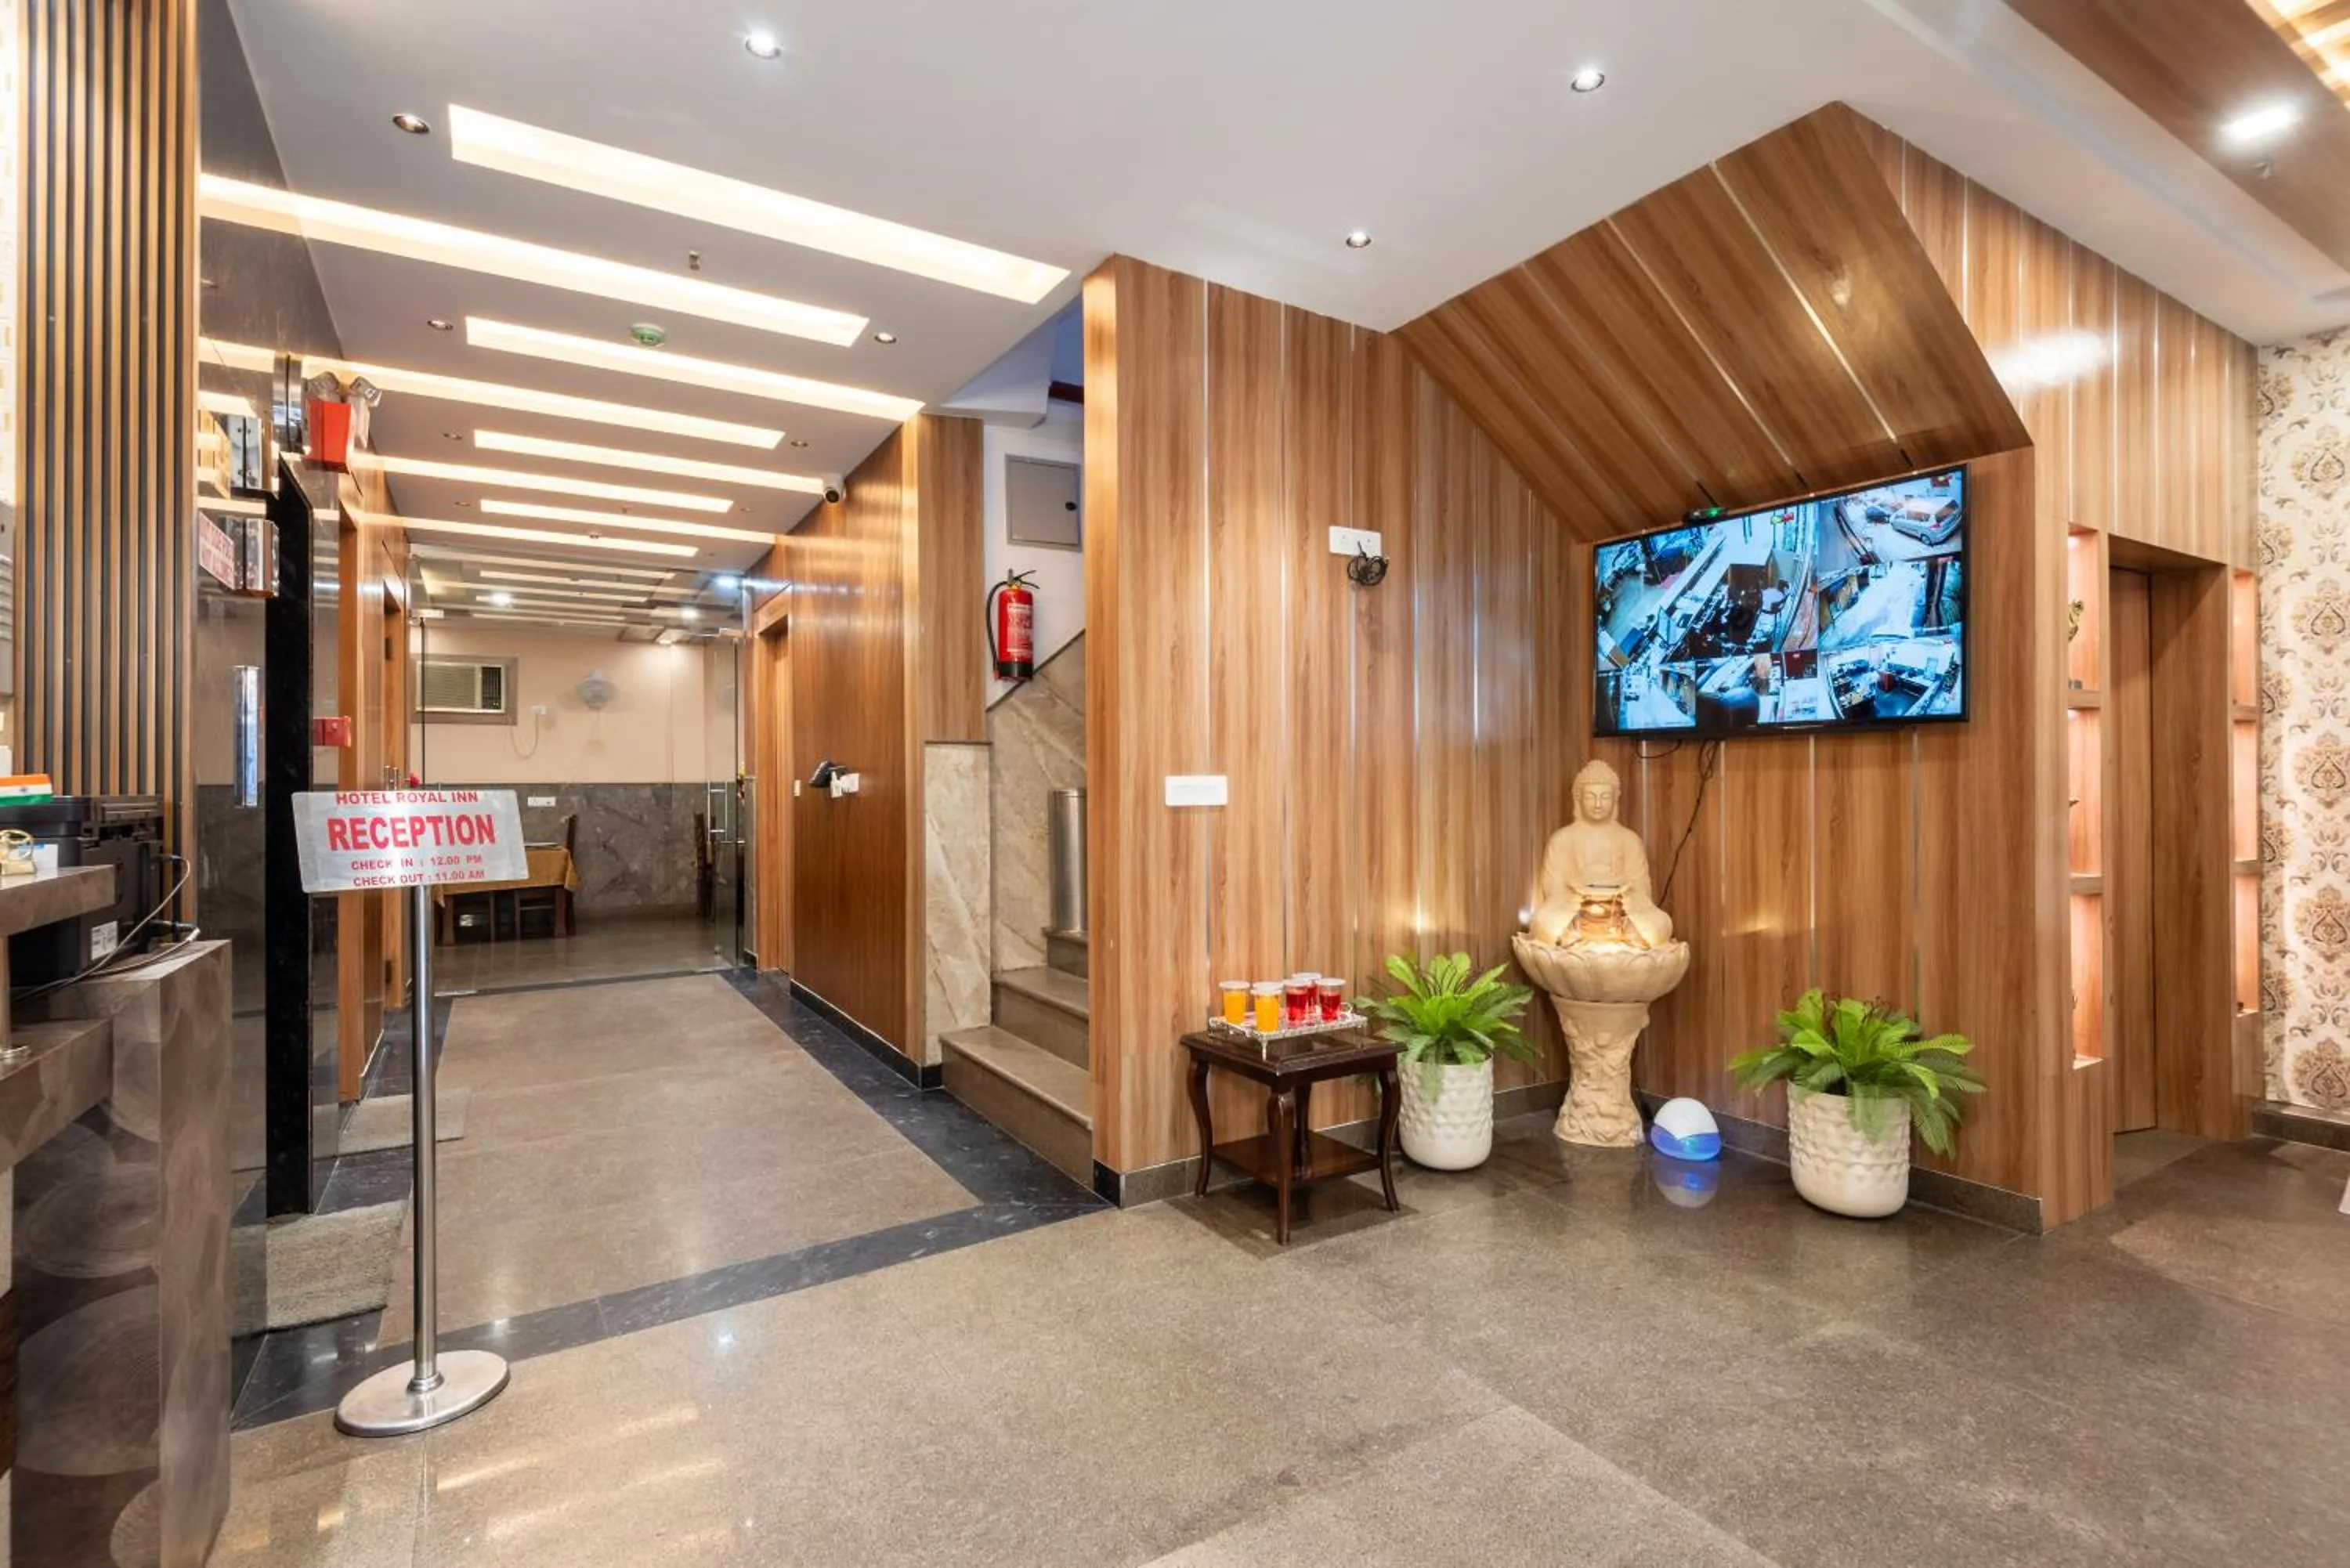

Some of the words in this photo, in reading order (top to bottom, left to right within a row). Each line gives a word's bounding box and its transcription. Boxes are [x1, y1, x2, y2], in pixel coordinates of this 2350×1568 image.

[336, 793, 391, 805] HOTEL
[396, 792, 447, 804] ROYAL
[451, 791, 479, 803] INN
[327, 814, 496, 851] RECEPTION
[351, 858, 392, 870] CHECK
[400, 858, 414, 867] IN
[430, 854, 460, 865] 12.00
[466, 853, 483, 864] PM
[353, 875, 396, 887] CHECK
[400, 873, 424, 883] OUT
[436, 870, 465, 881] 11.00
[468, 869, 485, 879] AM
